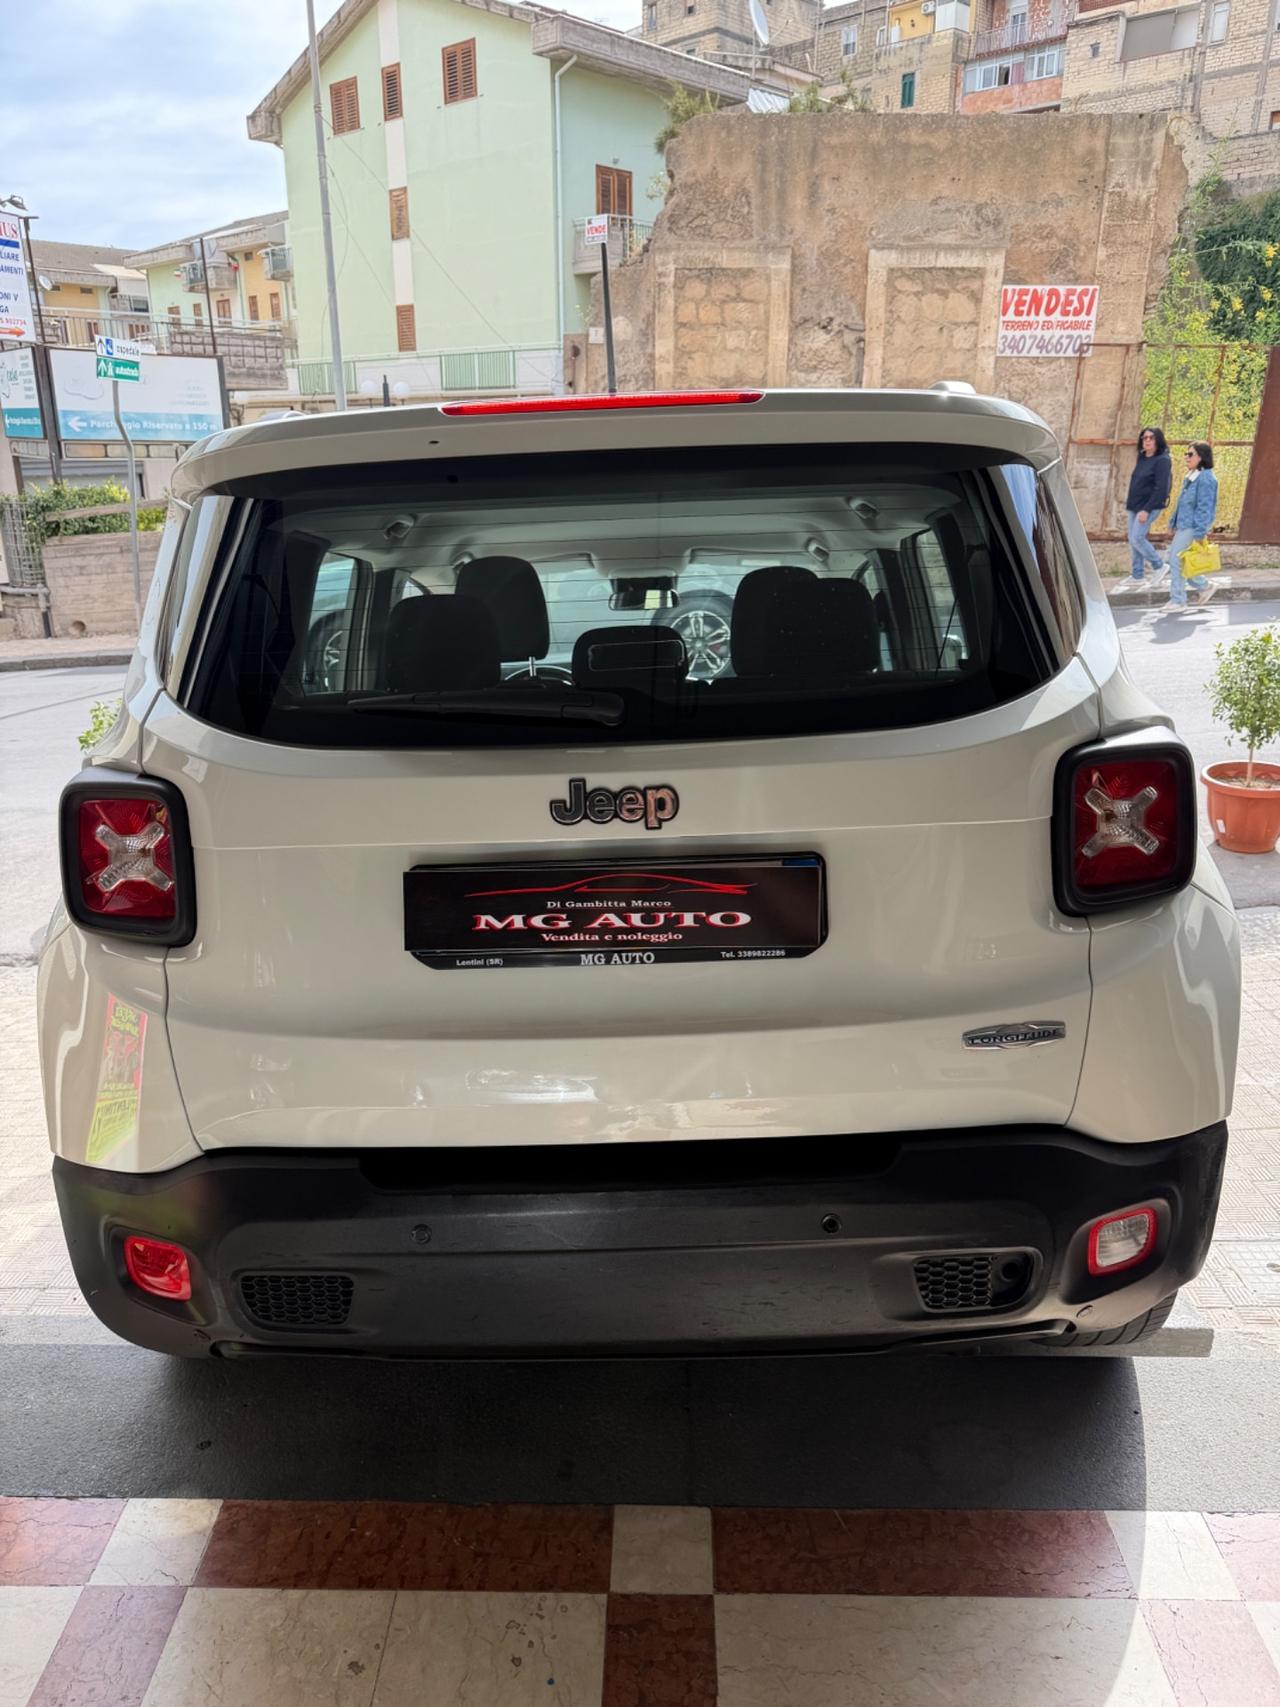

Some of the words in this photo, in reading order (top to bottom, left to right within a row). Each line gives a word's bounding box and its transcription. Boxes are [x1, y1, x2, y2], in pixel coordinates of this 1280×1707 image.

[1001, 287, 1099, 317] VENDESI
[550, 777, 680, 830] Jeep
[546, 900, 560, 909] Di
[565, 899, 627, 908] Gambitta
[631, 899, 672, 908] Marco
[472, 913, 572, 930] MG
[584, 911, 752, 929] AUTO
[541, 932, 599, 942] Vendita
[617, 932, 683, 943] noleggio
[456, 958, 484, 967] Lentini
[485, 958, 504, 967] (SR)
[580, 953, 605, 966] MG
[610, 952, 655, 965] AUTO
[968, 1029, 1060, 1045] LONGITUDE
